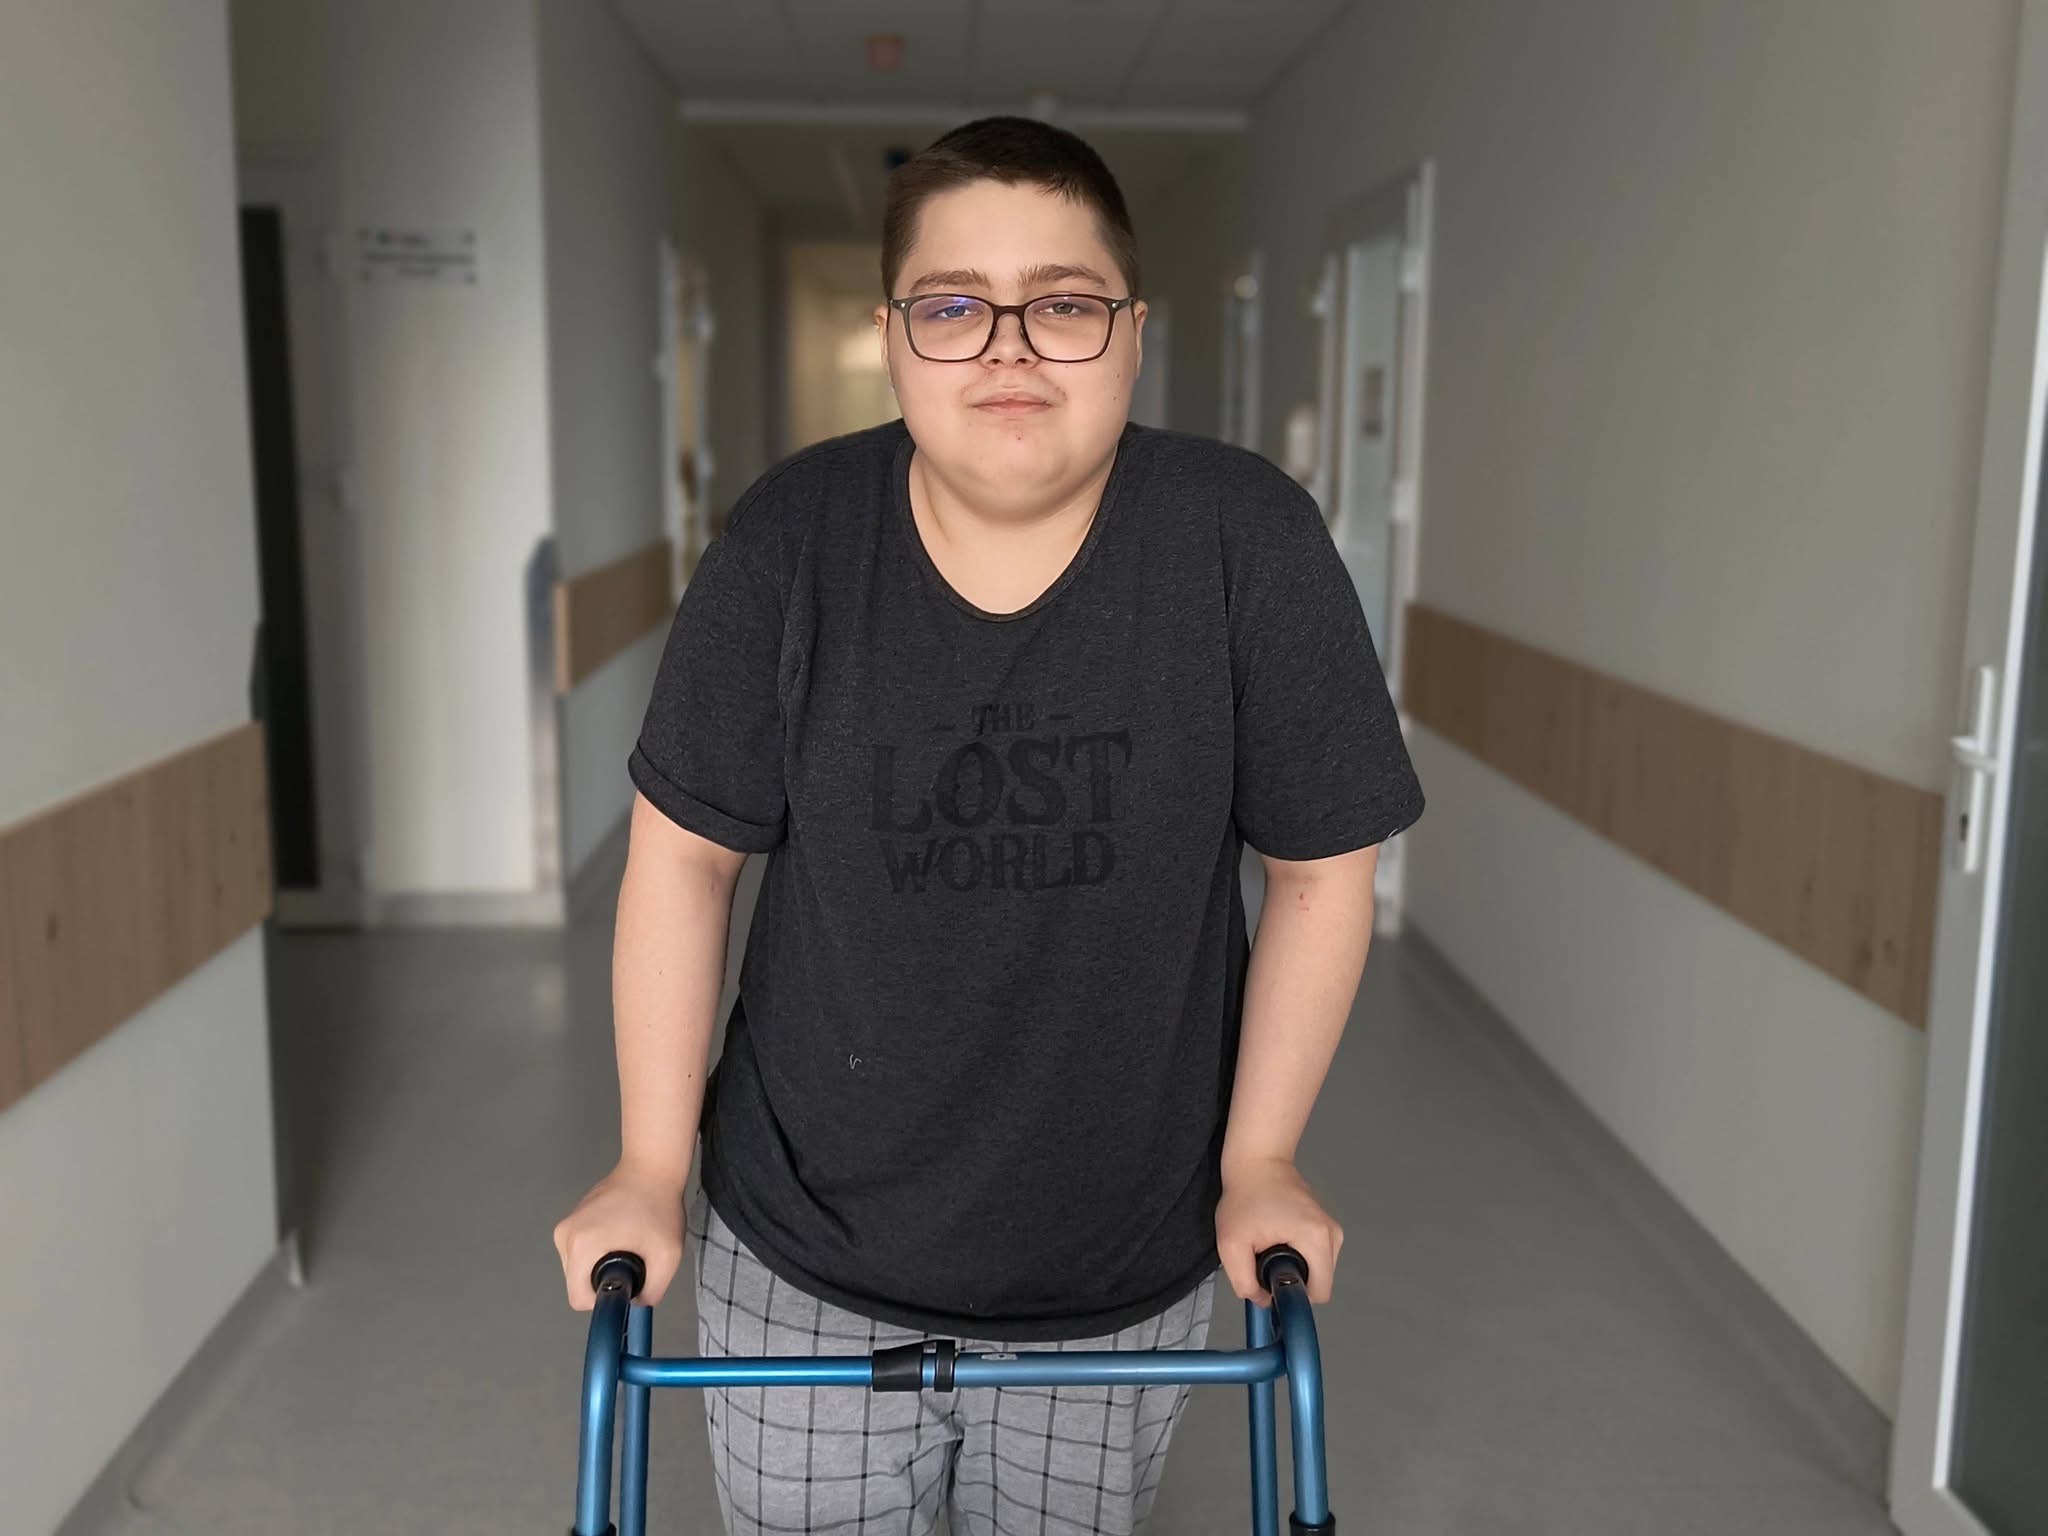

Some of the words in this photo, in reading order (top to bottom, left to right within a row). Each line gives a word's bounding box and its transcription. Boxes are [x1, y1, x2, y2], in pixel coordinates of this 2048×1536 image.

[972, 703, 1036, 735] THE
[871, 728, 1133, 833] LOST
[881, 830, 1116, 893] WORLD
